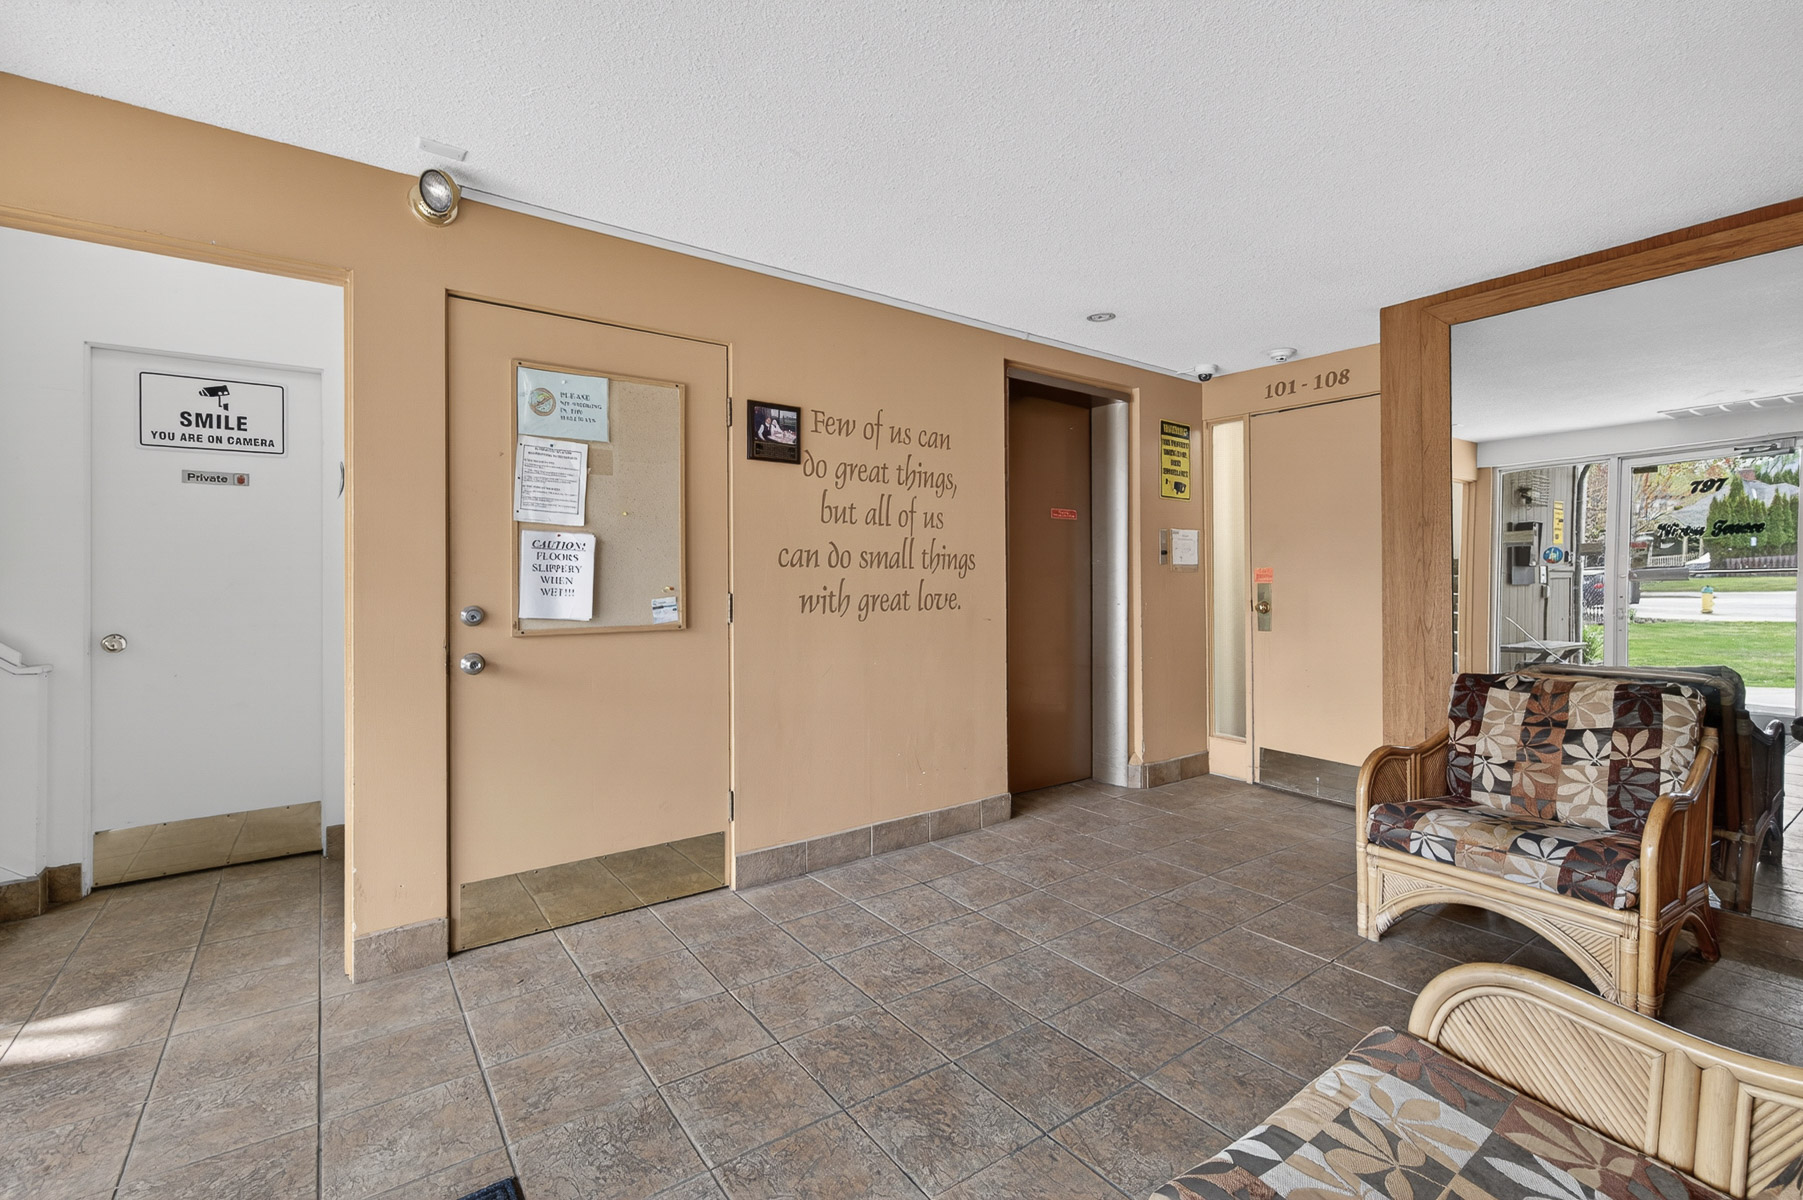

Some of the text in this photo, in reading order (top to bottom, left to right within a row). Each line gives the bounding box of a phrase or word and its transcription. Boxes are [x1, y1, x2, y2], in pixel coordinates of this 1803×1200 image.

[1264, 379, 1296, 399] 101
[1313, 368, 1350, 390] 108
[180, 411, 248, 432] SMILE
[810, 408, 952, 450] Few of us can
[150, 430, 275, 448] YOU ARE ON CAMERA
[187, 472, 228, 483] Private
[802, 449, 827, 478] do
[835, 462, 889, 490] great
[896, 453, 957, 499] things,
[1690, 477, 1729, 494] 797
[820, 488, 944, 537] but all of us
[531, 539, 586, 551] CAUTION!
[536, 551, 579, 561] FLOORS
[778, 537, 976, 579] can do small things
[532, 563, 582, 573] SLIPPERY
[540, 575, 573, 585] WHEN
[540, 588, 575, 597] WET!!!
[798, 578, 961, 622] with great love.
